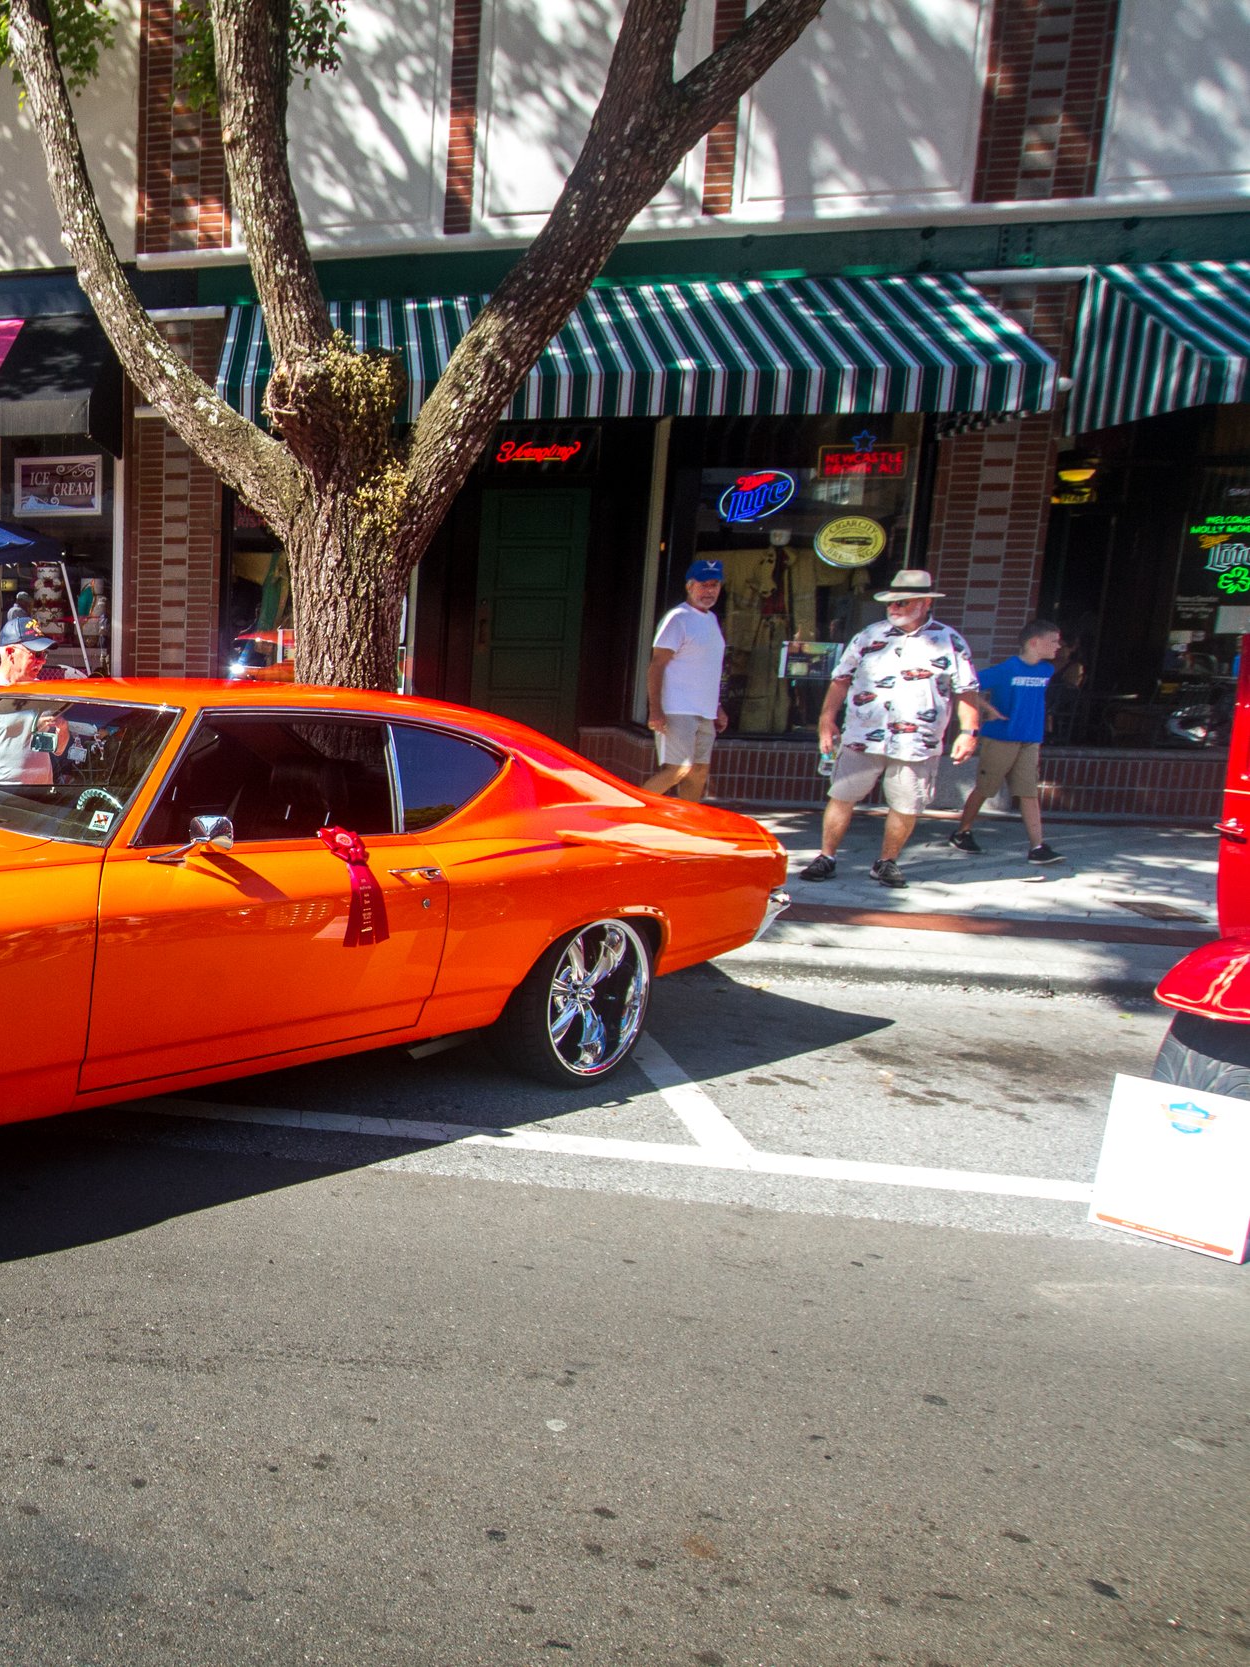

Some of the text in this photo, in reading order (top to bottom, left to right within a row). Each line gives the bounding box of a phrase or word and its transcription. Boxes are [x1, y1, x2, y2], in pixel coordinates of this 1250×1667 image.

[824, 451, 904, 464] NEWCASTLE
[30, 471, 50, 486] ICE
[53, 482, 93, 496] CREAM
[726, 480, 790, 522] Lite
[829, 520, 878, 534] CIGAR CITY
[1189, 525, 1225, 534] MOLLY
